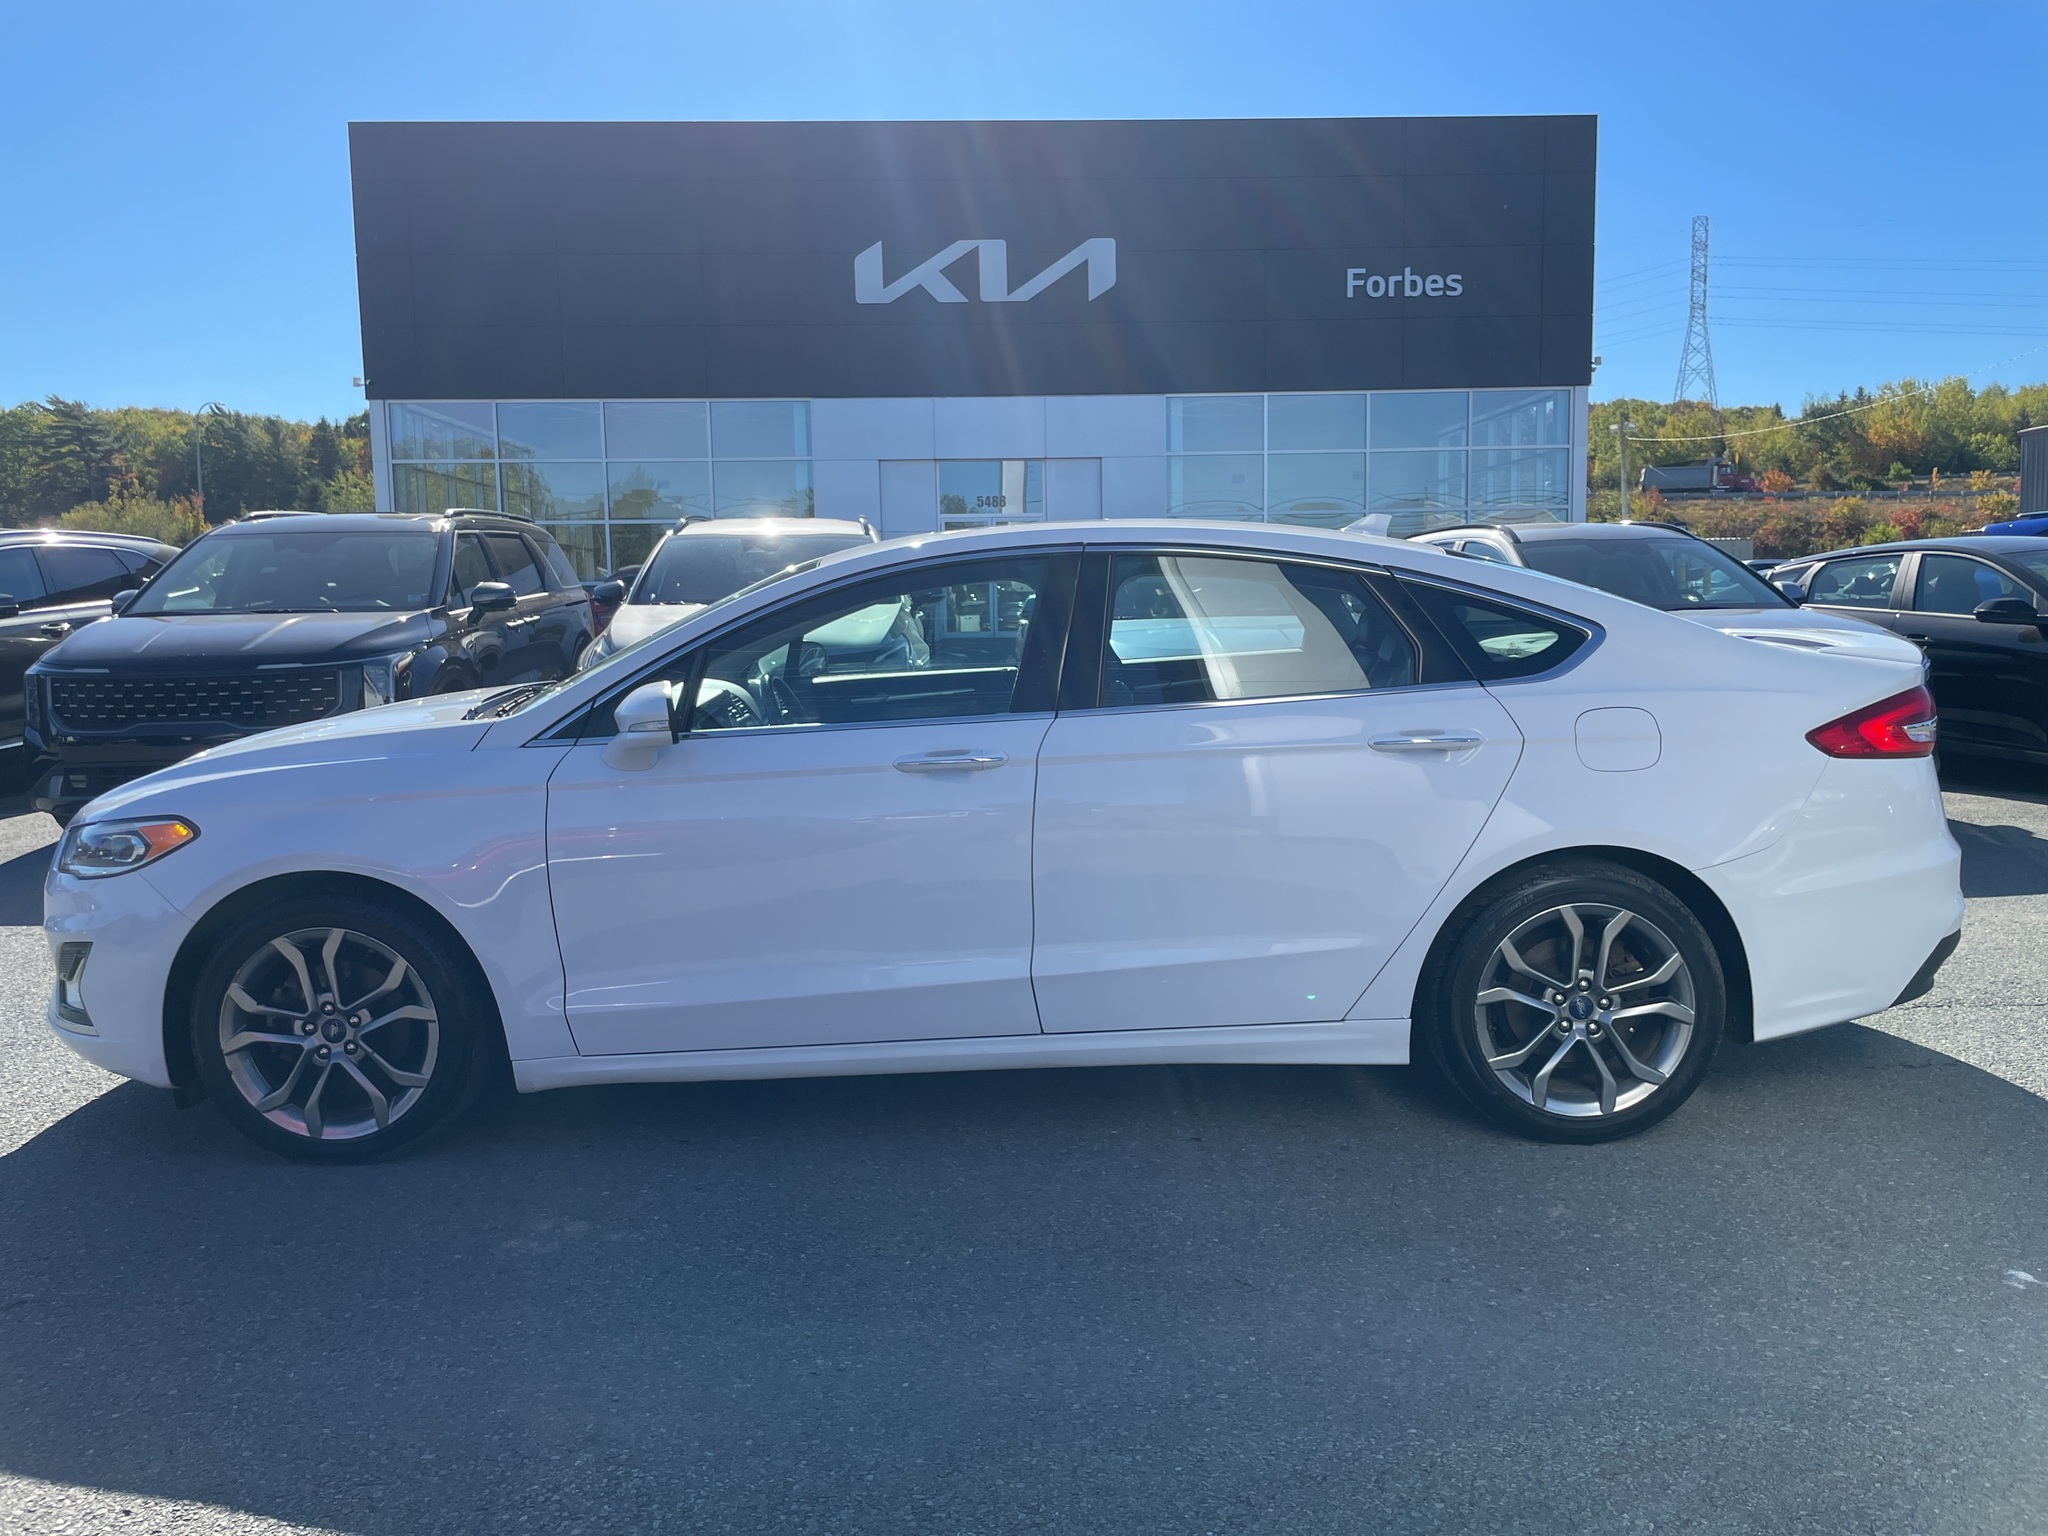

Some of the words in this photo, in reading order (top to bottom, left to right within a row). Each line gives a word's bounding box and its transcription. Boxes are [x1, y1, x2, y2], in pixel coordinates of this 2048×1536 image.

[854, 238, 1117, 304] KIA
[1346, 266, 1463, 298] Forbes
[976, 496, 1006, 508] 5488
